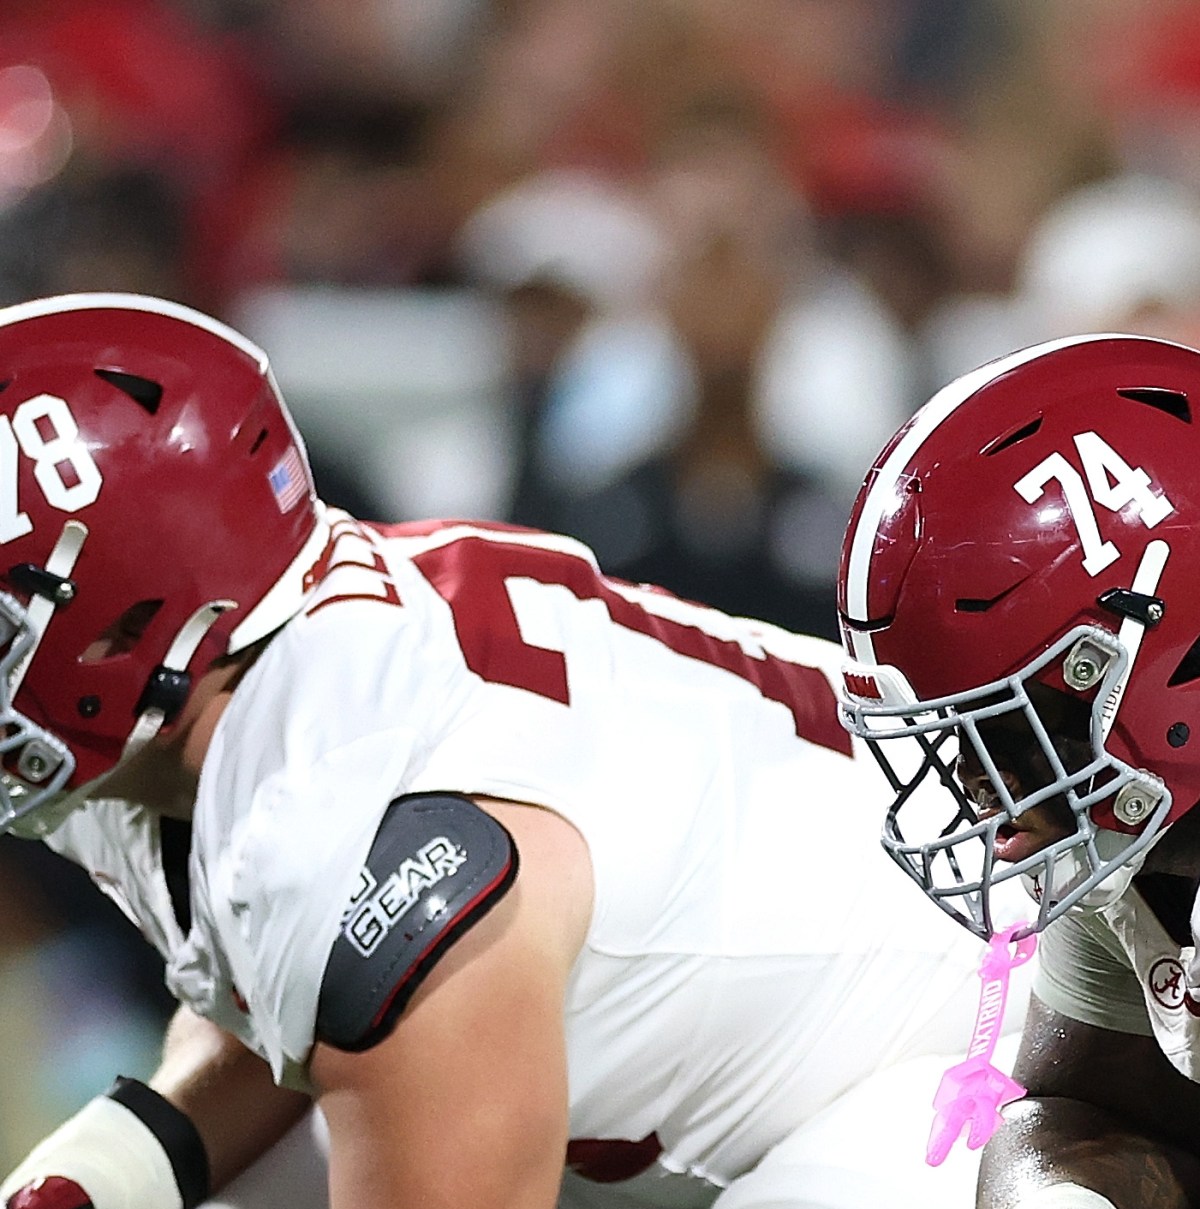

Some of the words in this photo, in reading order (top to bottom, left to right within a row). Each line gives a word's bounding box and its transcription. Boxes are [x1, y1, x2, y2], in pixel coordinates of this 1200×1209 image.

[1013, 430, 1175, 578] 74
[345, 836, 461, 958] GEAR
[966, 979, 1003, 1060] NXTRND
